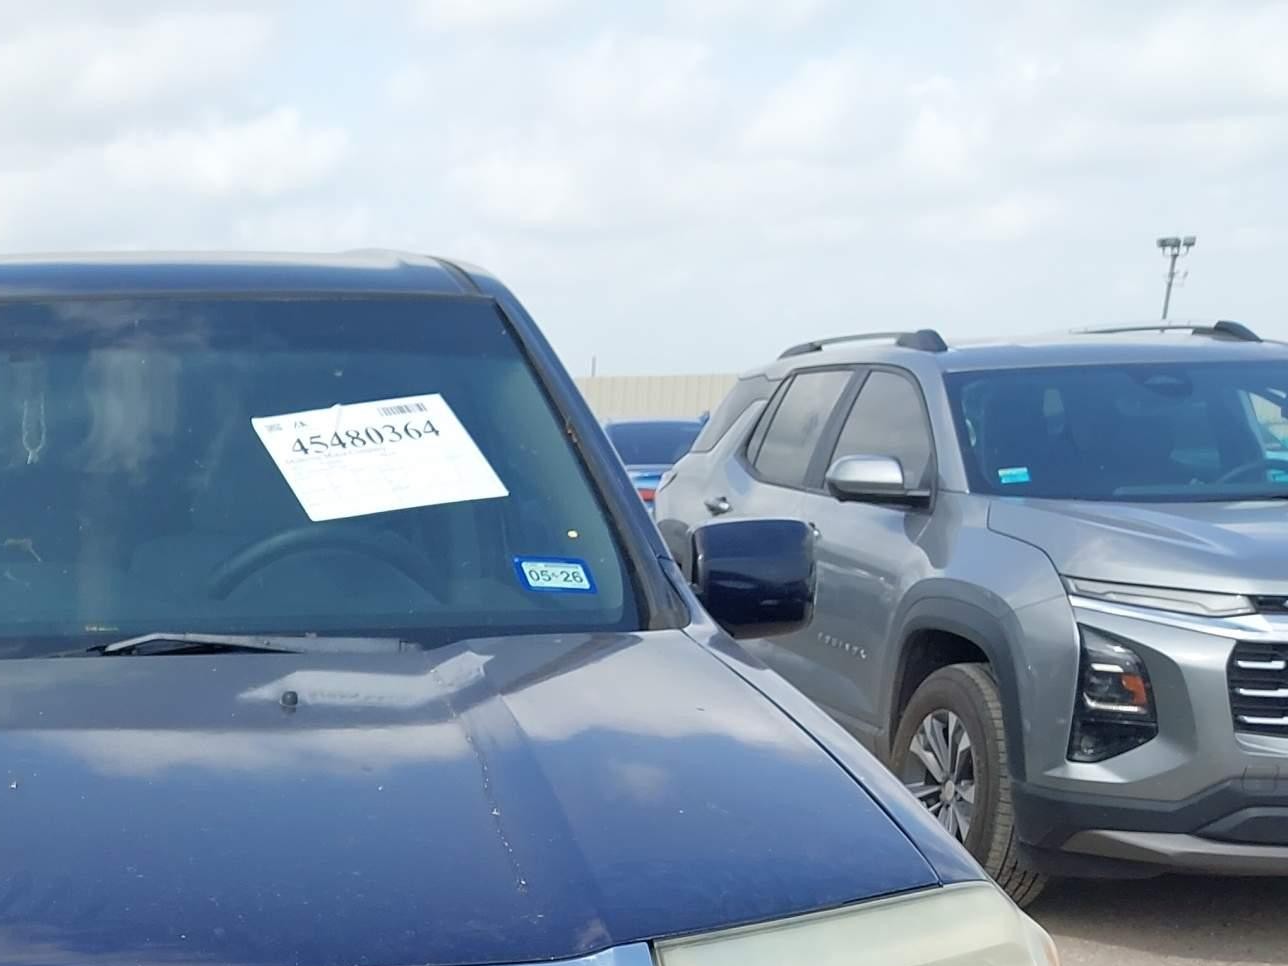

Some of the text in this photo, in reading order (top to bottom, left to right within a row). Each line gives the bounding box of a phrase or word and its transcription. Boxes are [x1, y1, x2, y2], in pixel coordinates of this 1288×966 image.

[291, 418, 441, 456] 45480364
[528, 569, 584, 583] 05 26
